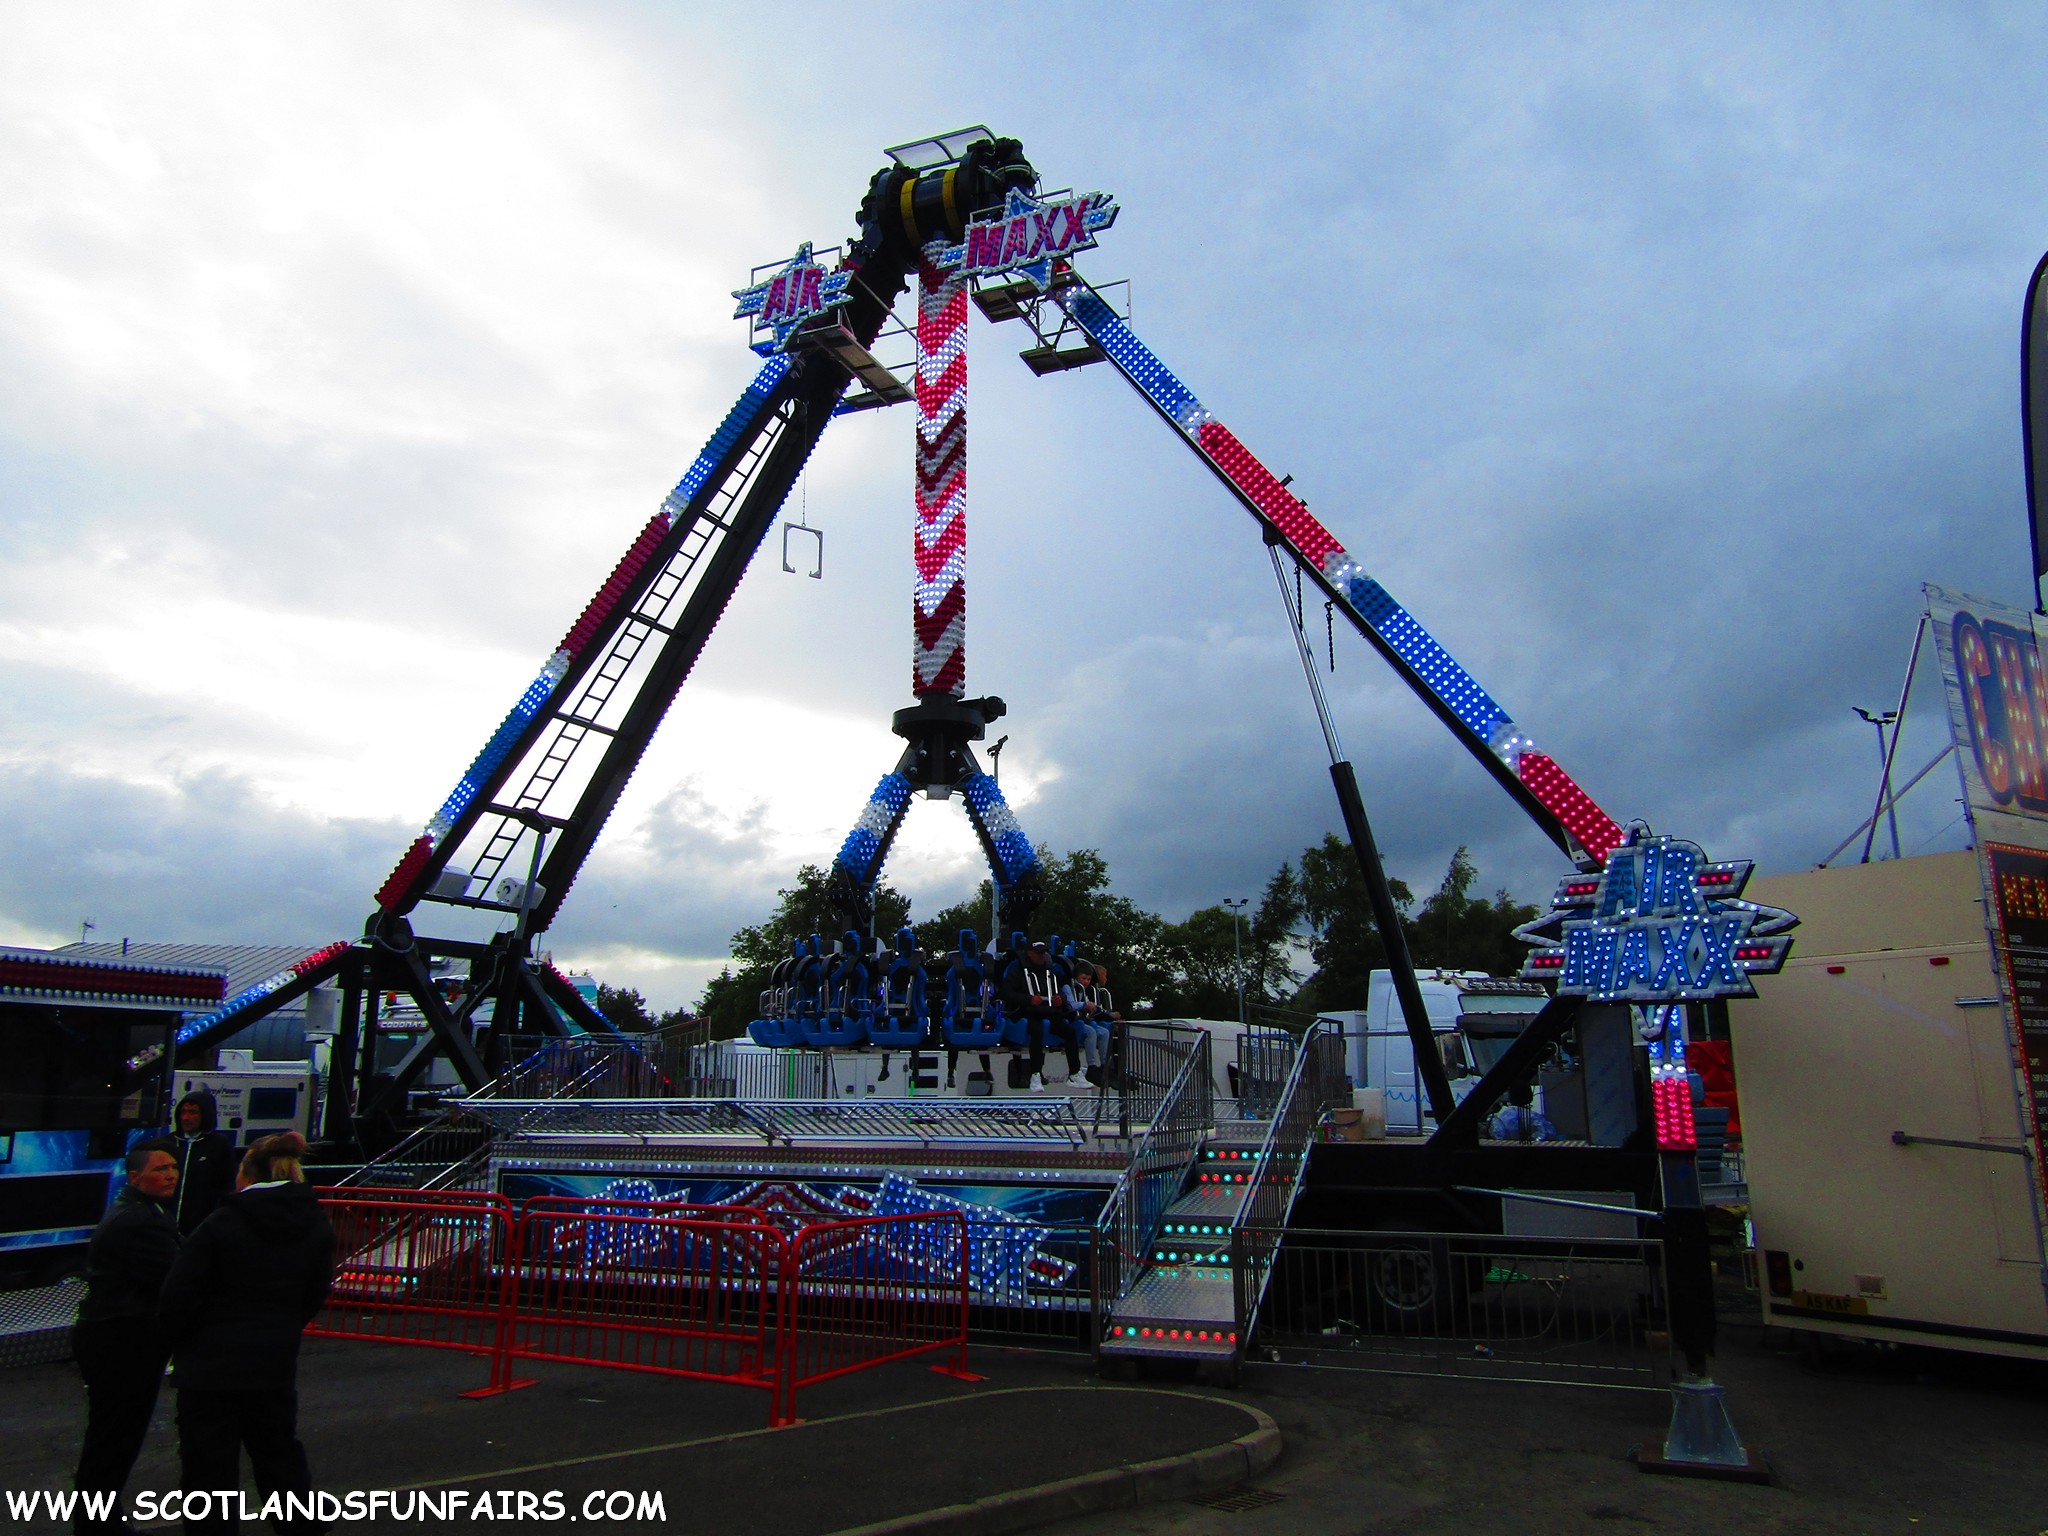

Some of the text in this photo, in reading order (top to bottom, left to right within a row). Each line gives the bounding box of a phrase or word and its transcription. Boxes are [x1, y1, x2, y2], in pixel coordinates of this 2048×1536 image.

[762, 198, 1090, 323] AIR MAXX
[1601, 846, 1699, 917] AIR
[1565, 919, 1742, 991] MAXX
